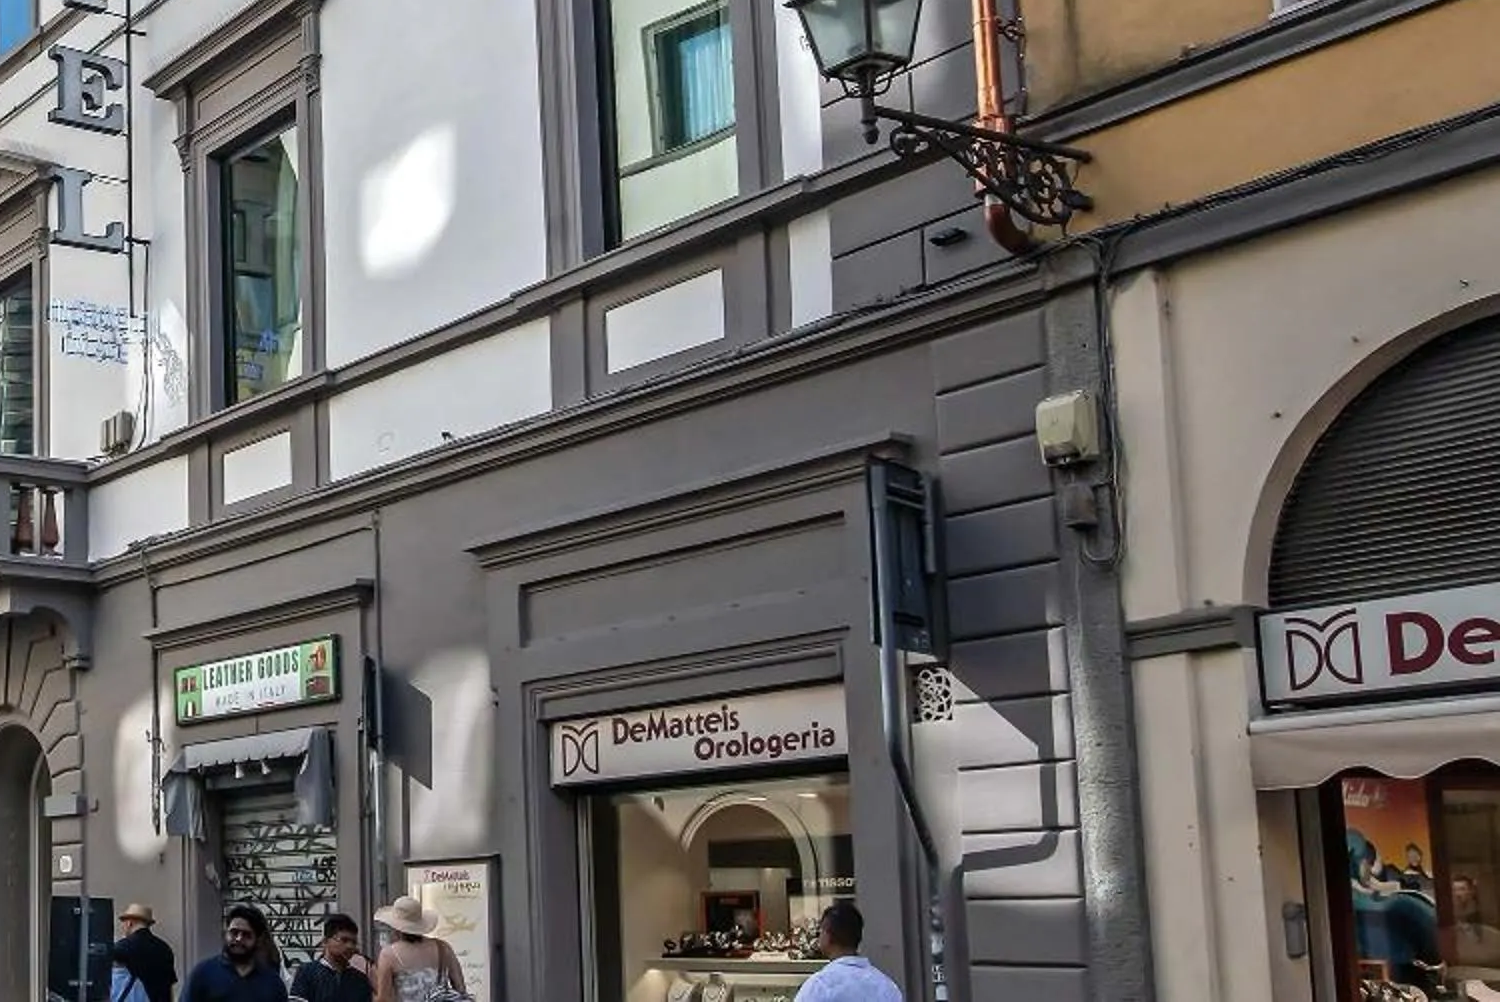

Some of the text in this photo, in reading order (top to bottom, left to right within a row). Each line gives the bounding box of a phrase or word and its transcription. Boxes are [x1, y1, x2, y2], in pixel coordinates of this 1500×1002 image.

[203, 649, 299, 690] LEATHER GOODS
[215, 691, 240, 706] MADE
[259, 684, 287, 700] ITALY
[611, 703, 740, 745] DeMatteis
[694, 721, 836, 760] Orologeria
